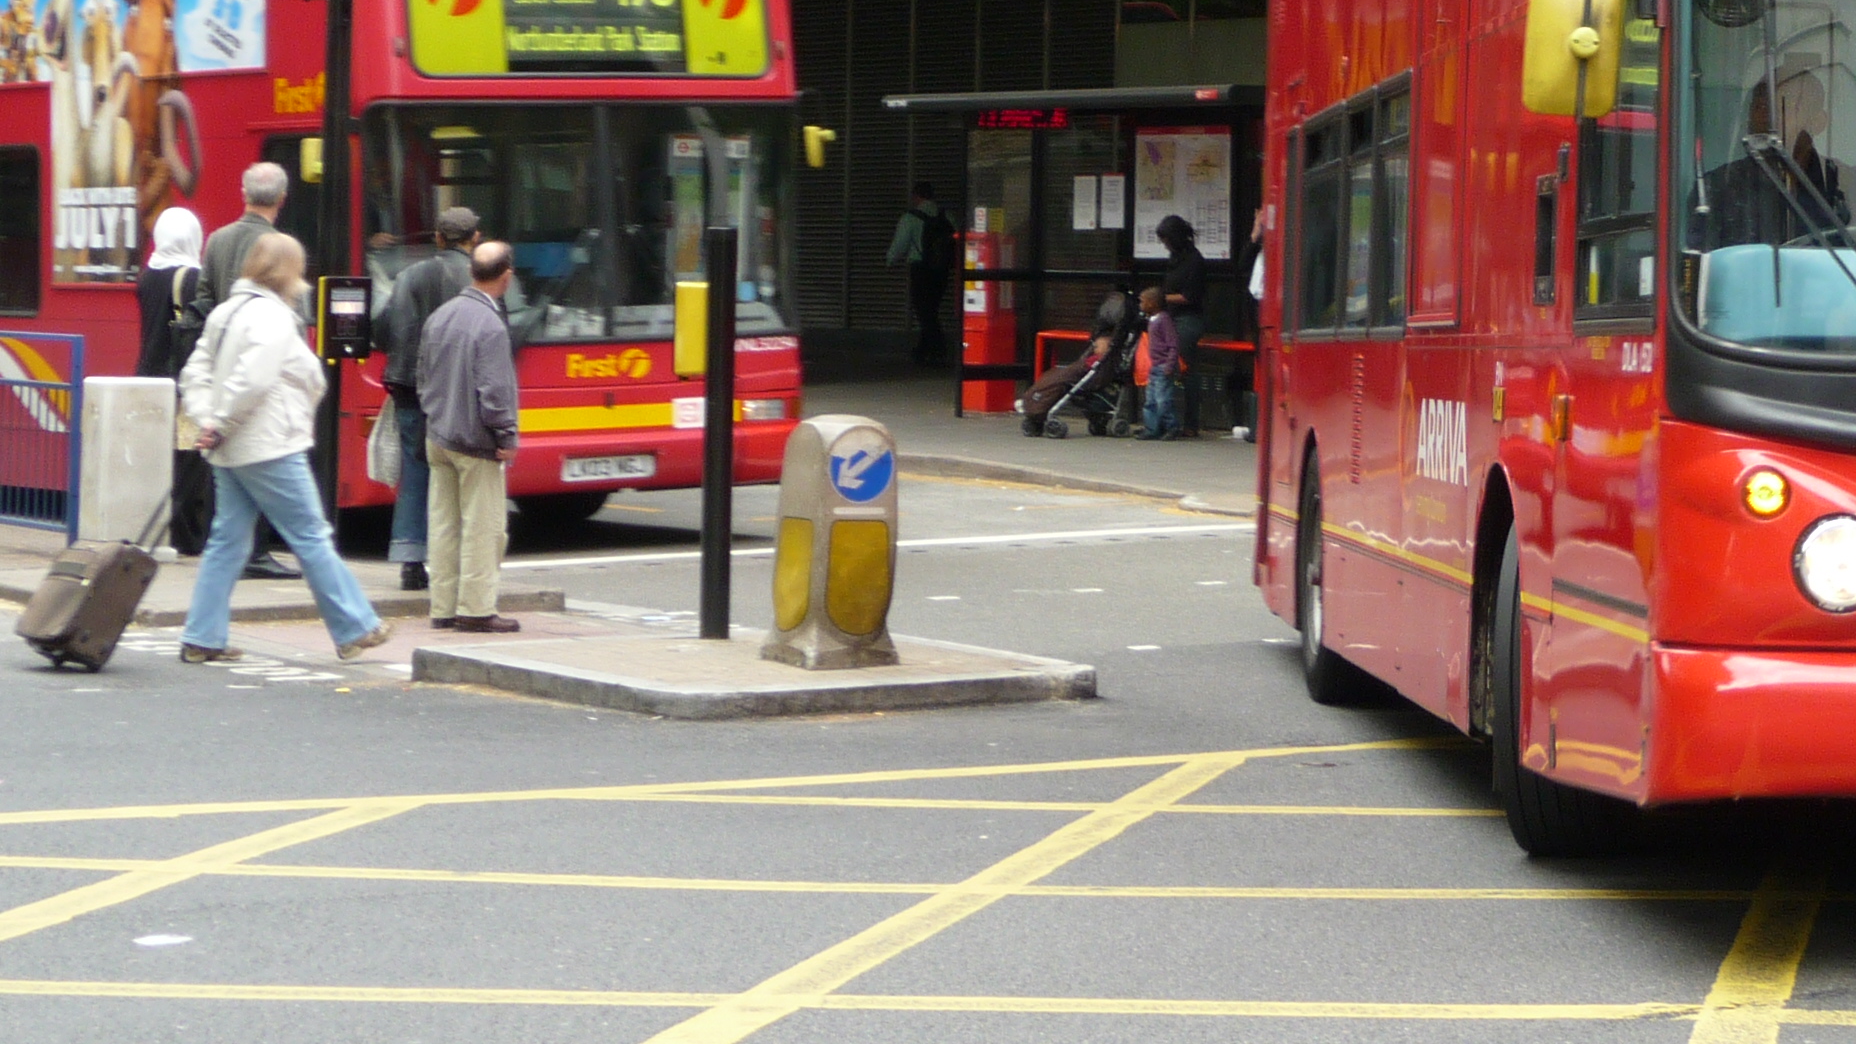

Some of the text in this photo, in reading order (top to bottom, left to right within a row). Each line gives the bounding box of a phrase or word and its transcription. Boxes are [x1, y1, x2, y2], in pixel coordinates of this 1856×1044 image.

[54, 206, 120, 249] JULY
[566, 353, 618, 378] First
[1416, 398, 1467, 487] ARRIVA
